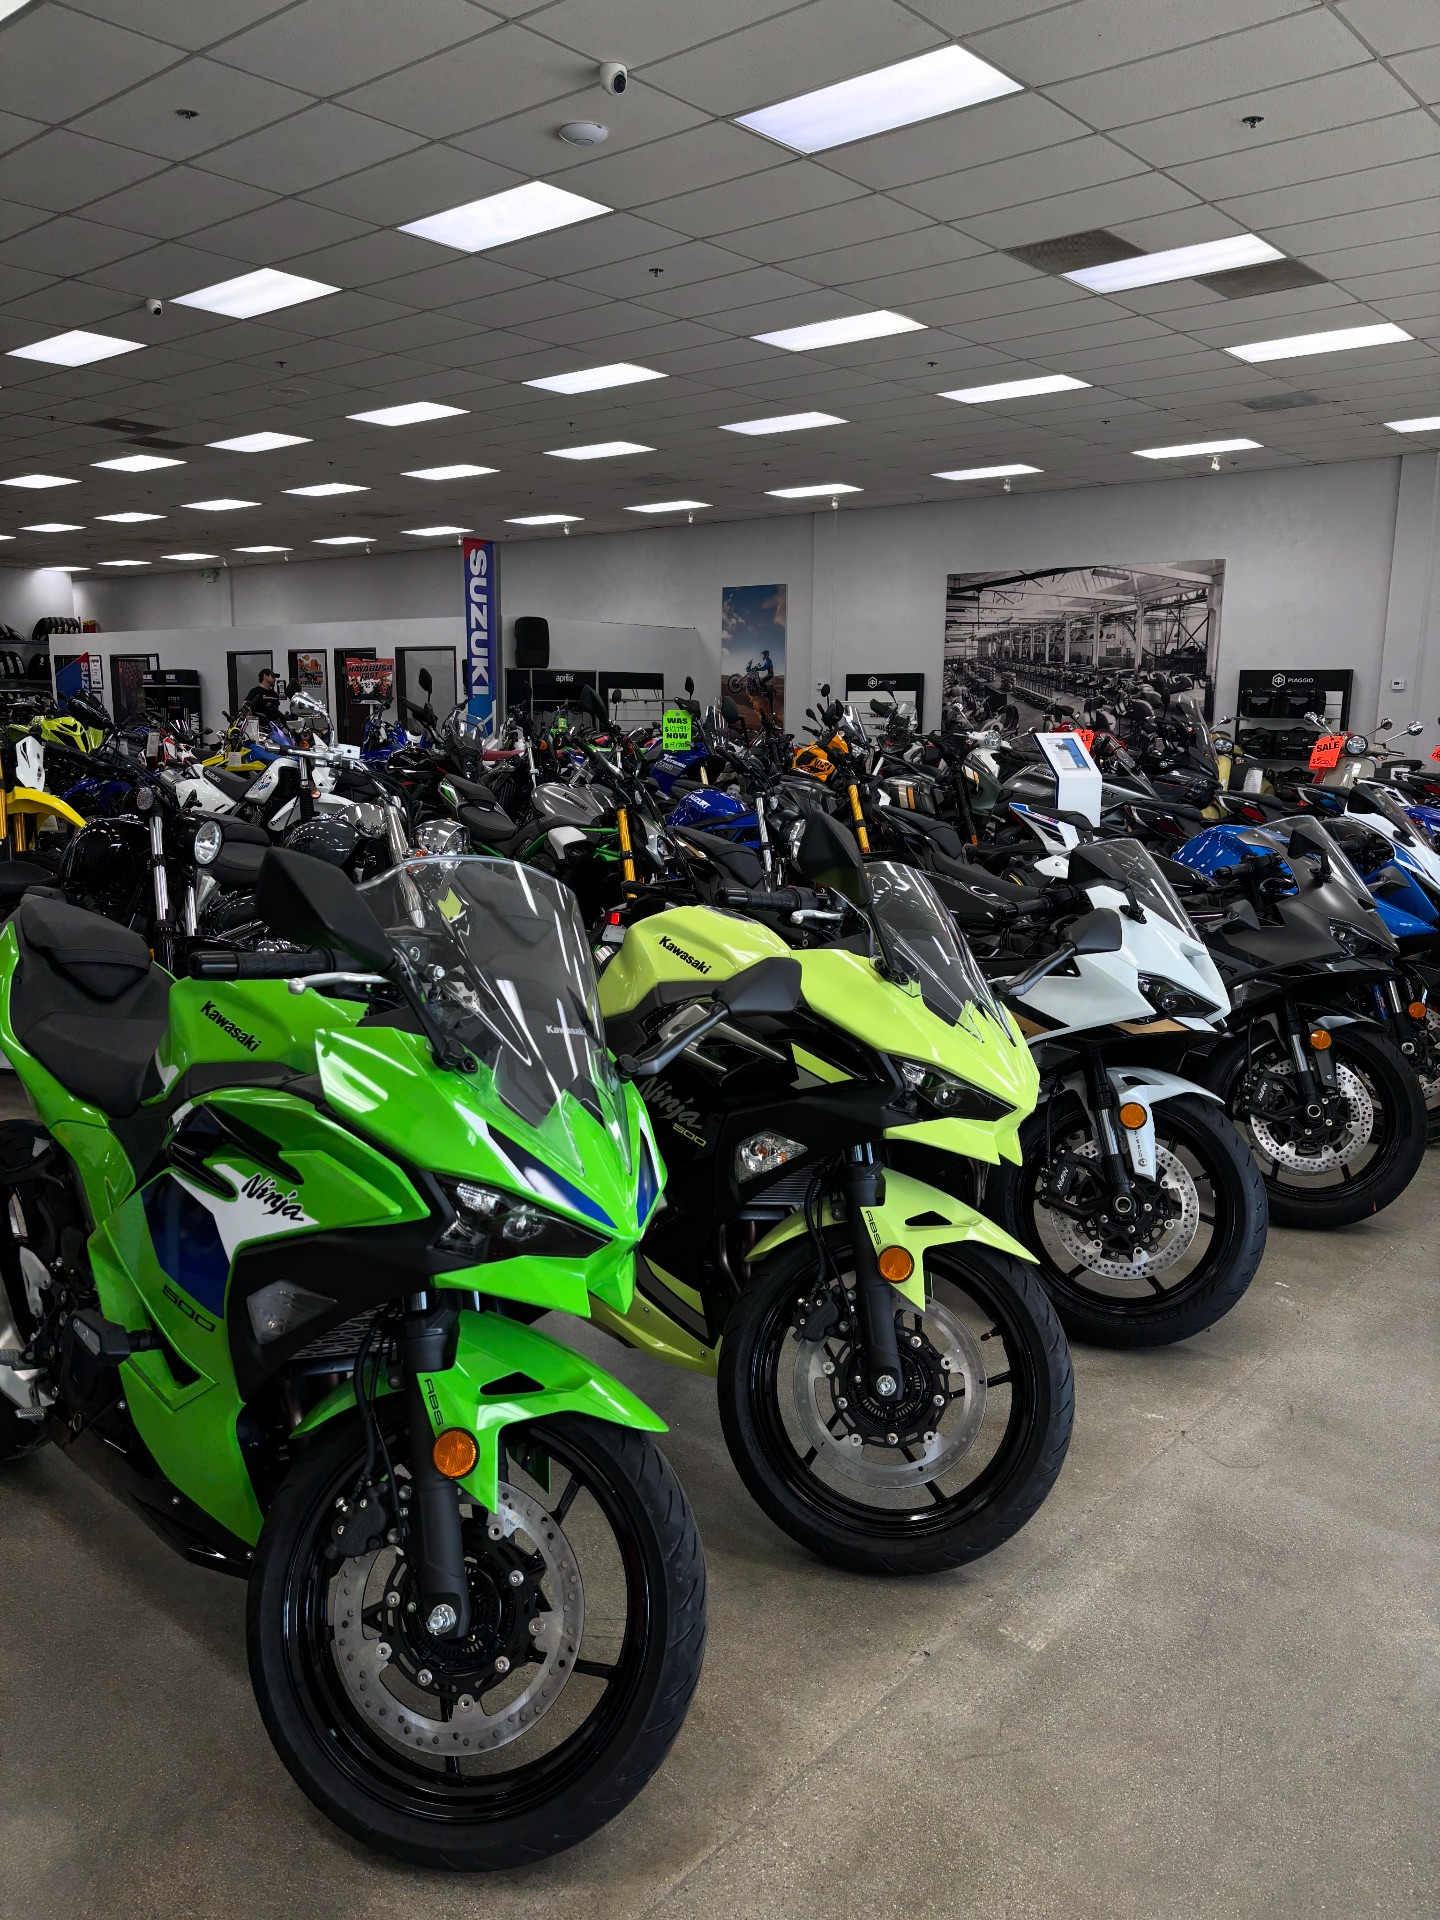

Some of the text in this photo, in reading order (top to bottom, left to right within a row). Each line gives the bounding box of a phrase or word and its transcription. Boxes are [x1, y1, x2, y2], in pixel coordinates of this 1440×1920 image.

[469, 548, 489, 695] SUZUKI
[80, 661, 90, 690] SUZ
[348, 664, 393, 673] HAYABUSA
[360, 672, 379, 681] FAST
[666, 717, 688, 725] WAS
[1316, 741, 1340, 753] SALE
[204, 769, 222, 783] SUZUKI
[562, 792, 588, 812] Kawasaki
[688, 794, 711, 809] SUZUKI
[658, 935, 712, 975] Kawasaki
[200, 999, 263, 1053] Kawasaki
[638, 1075, 703, 1130] Ninja
[672, 1122, 707, 1147] 500
[1056, 1165, 1070, 1191] NISSIN
[241, 1173, 305, 1222] Ninja
[865, 1210, 882, 1246] ABS
[161, 1283, 217, 1333] 500
[424, 1377, 444, 1426] ABS
